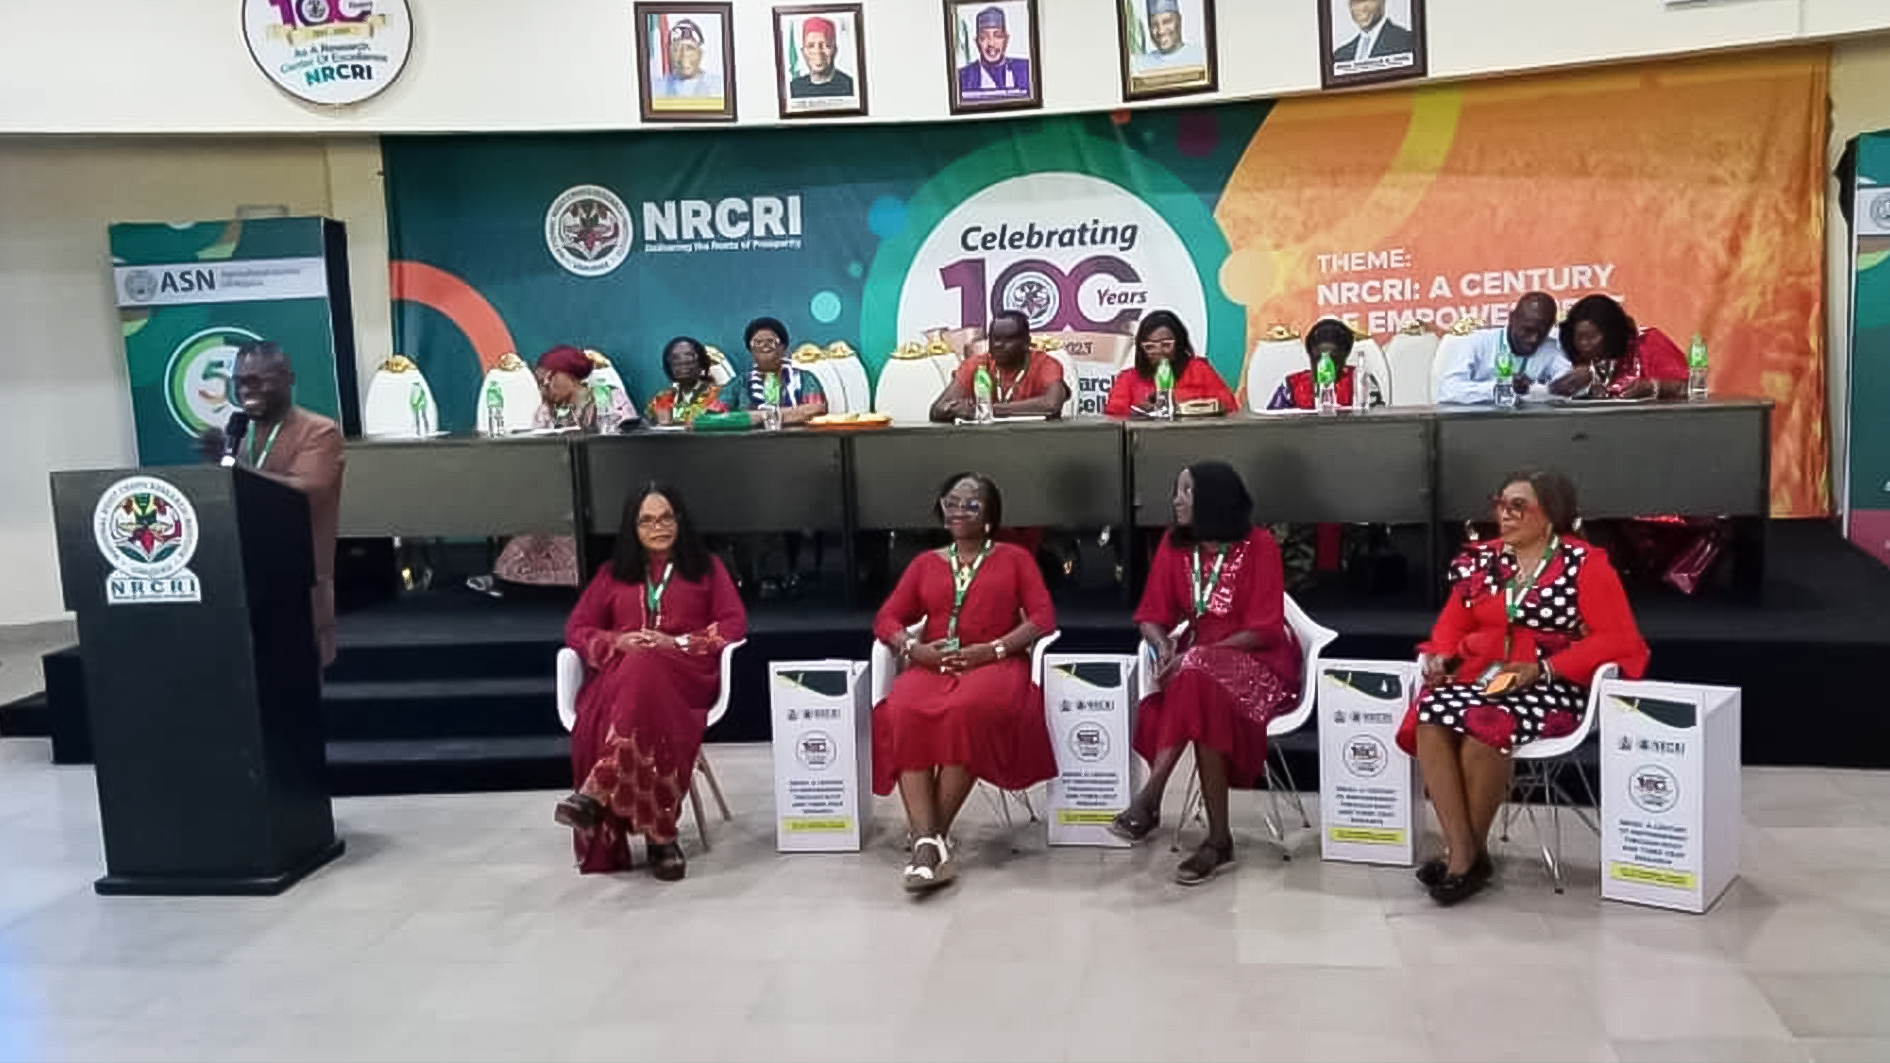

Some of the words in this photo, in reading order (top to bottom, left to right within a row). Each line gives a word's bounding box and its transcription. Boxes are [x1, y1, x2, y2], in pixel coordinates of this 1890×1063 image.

[304, 63, 373, 86] NRCRI
[643, 195, 801, 241] NRCRI
[961, 220, 1138, 251] Celebrating
[1316, 248, 1412, 273] THEME:
[160, 269, 216, 293] ASN
[1317, 278, 1420, 306] NRCRI:
[1428, 276, 1453, 299] A
[1459, 263, 1615, 297] CENTURY
[1096, 288, 1149, 307] Years
[111, 580, 195, 594] NRCRI
